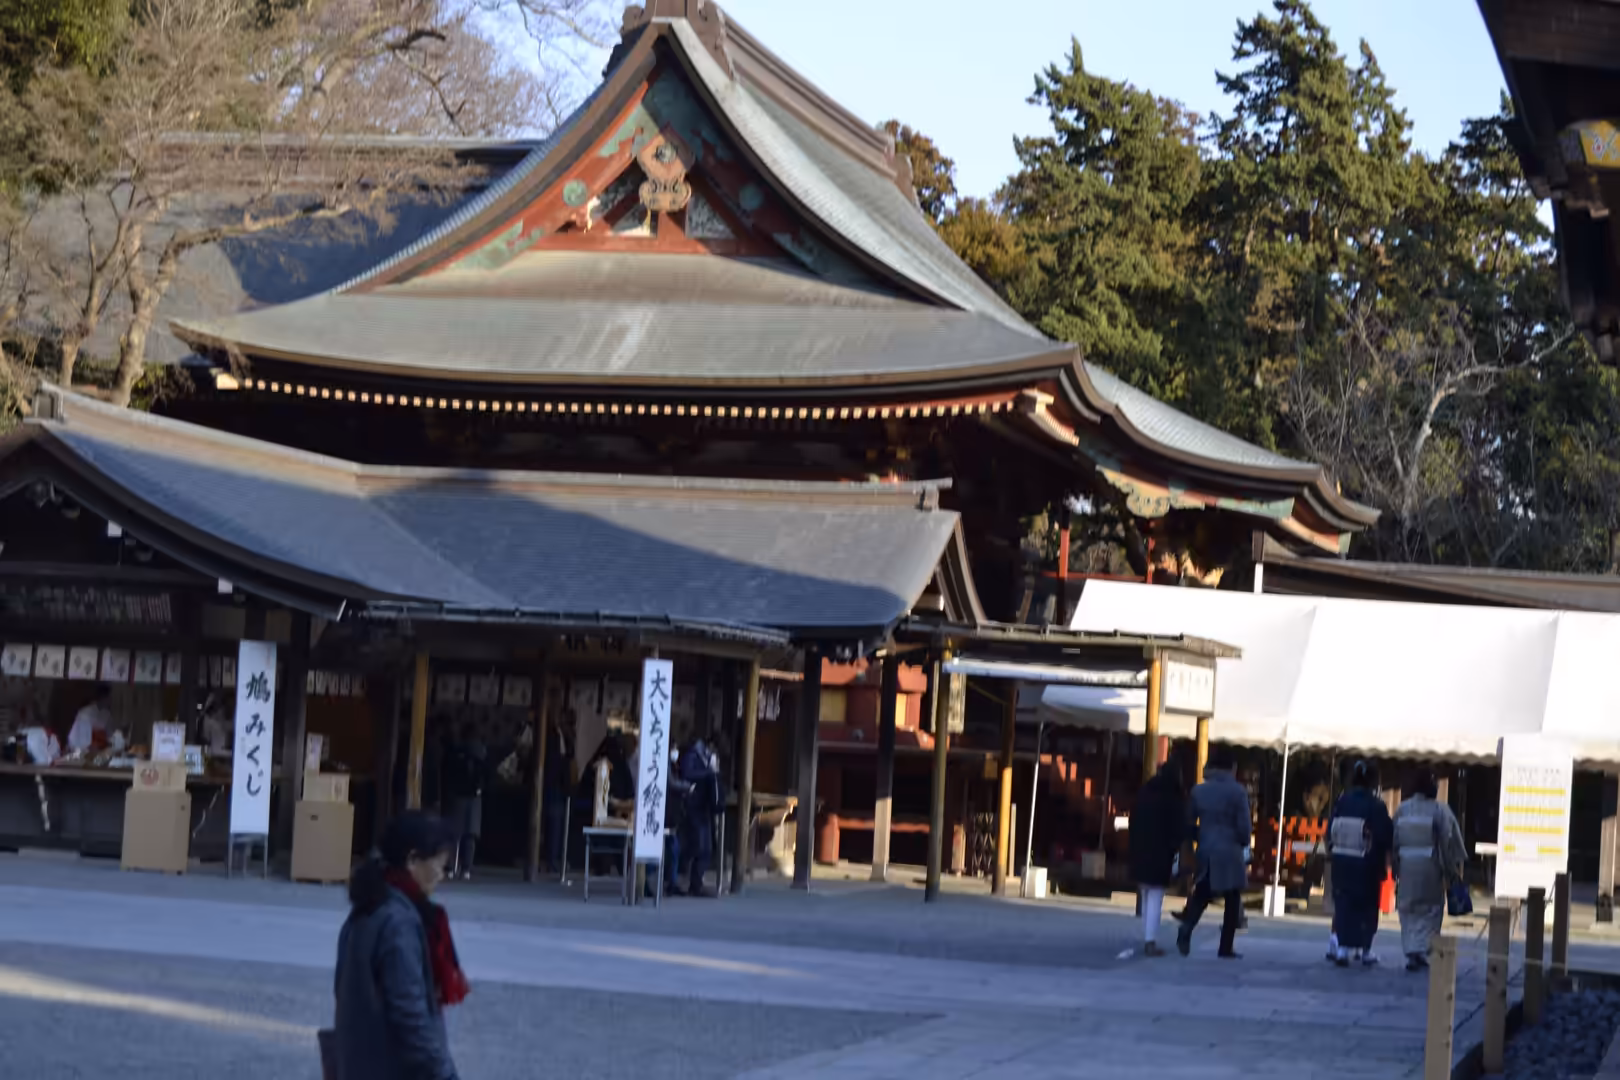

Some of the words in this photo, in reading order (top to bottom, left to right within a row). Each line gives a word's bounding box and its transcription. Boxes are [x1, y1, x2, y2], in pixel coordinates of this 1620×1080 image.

[245, 671, 271, 797] 鳩みくじ
[643, 669, 669, 837] 大いちょう絵馬
